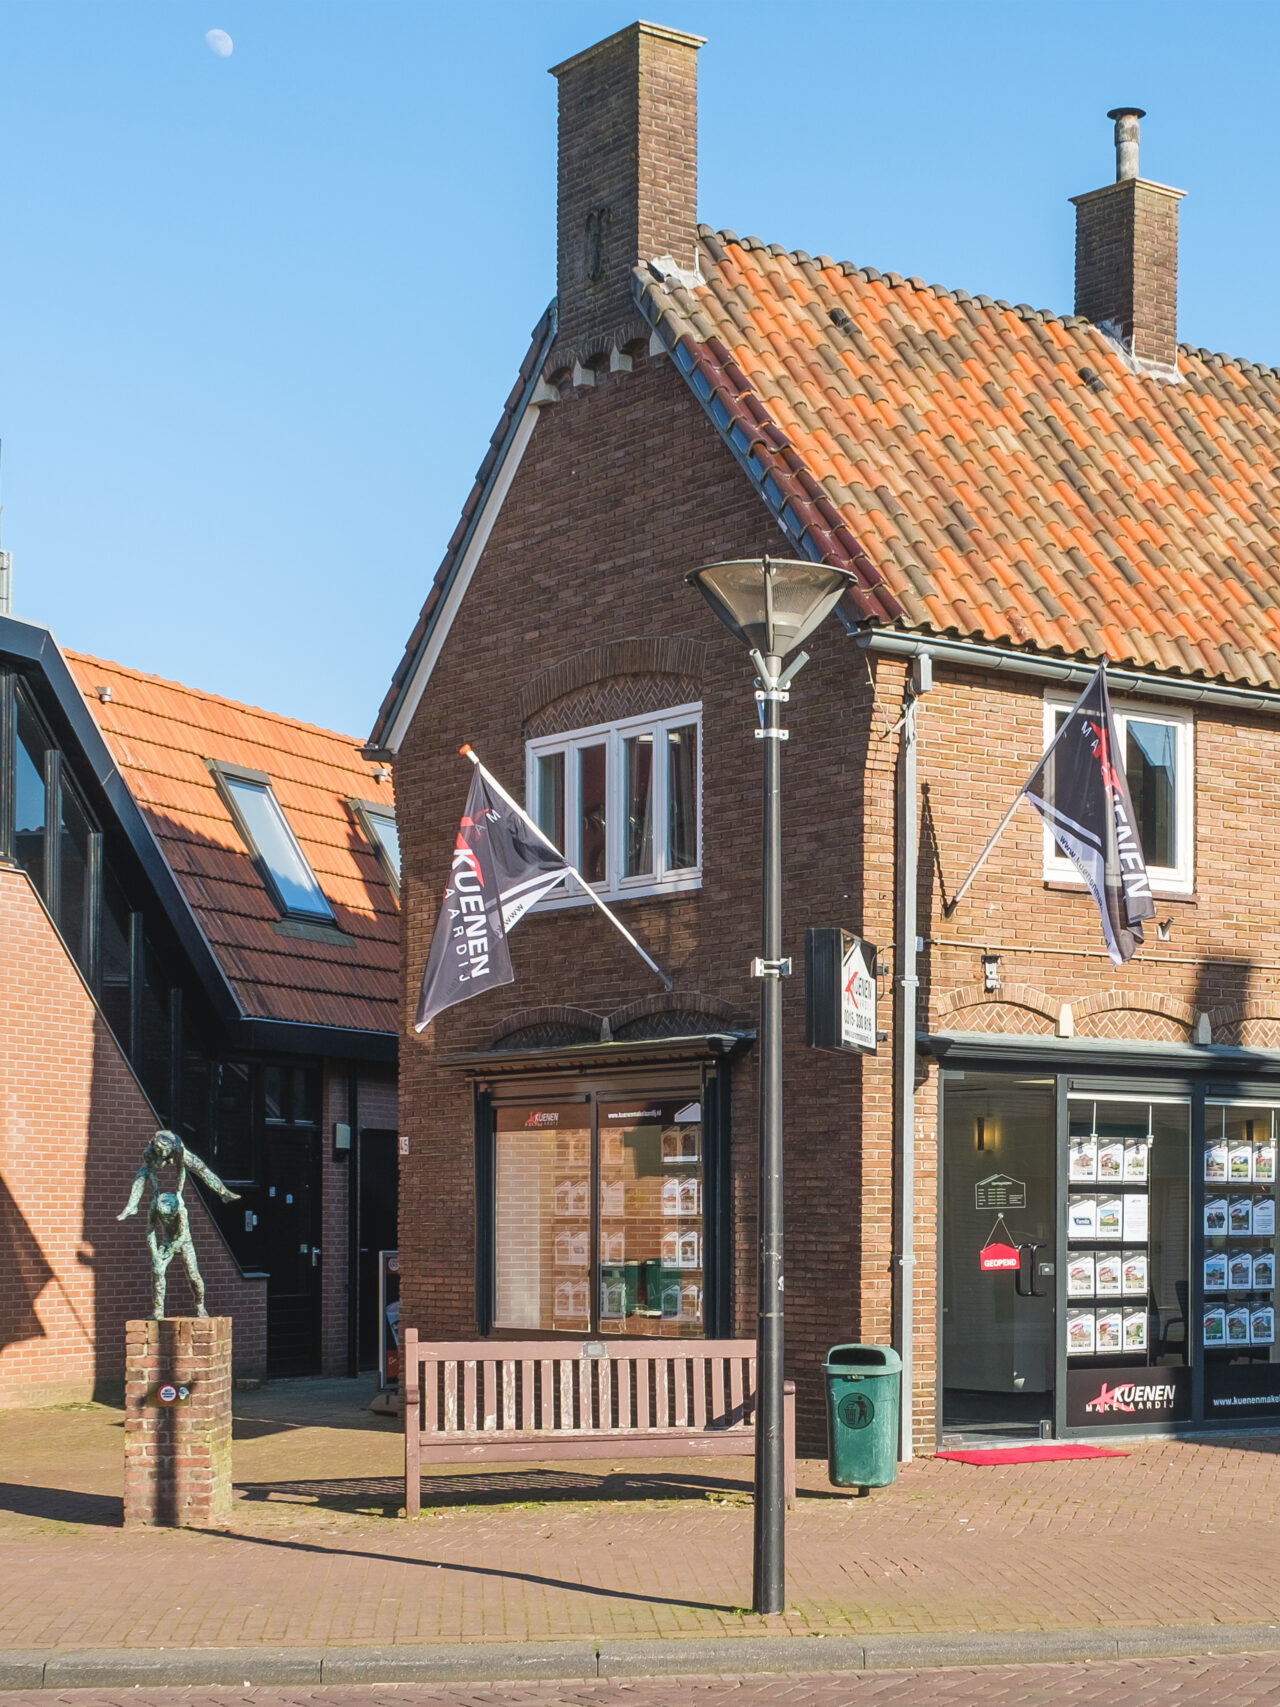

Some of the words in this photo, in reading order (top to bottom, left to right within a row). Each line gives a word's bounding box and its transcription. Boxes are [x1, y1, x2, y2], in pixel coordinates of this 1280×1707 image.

[452, 848, 490, 978] KUENEN
[534, 1112, 559, 1122] KUENEN
[983, 1258, 1017, 1267] GEOPEND
[1114, 1384, 1177, 1403] KUENEN
[1085, 1400, 1175, 1413] MAKELAARDIJ
